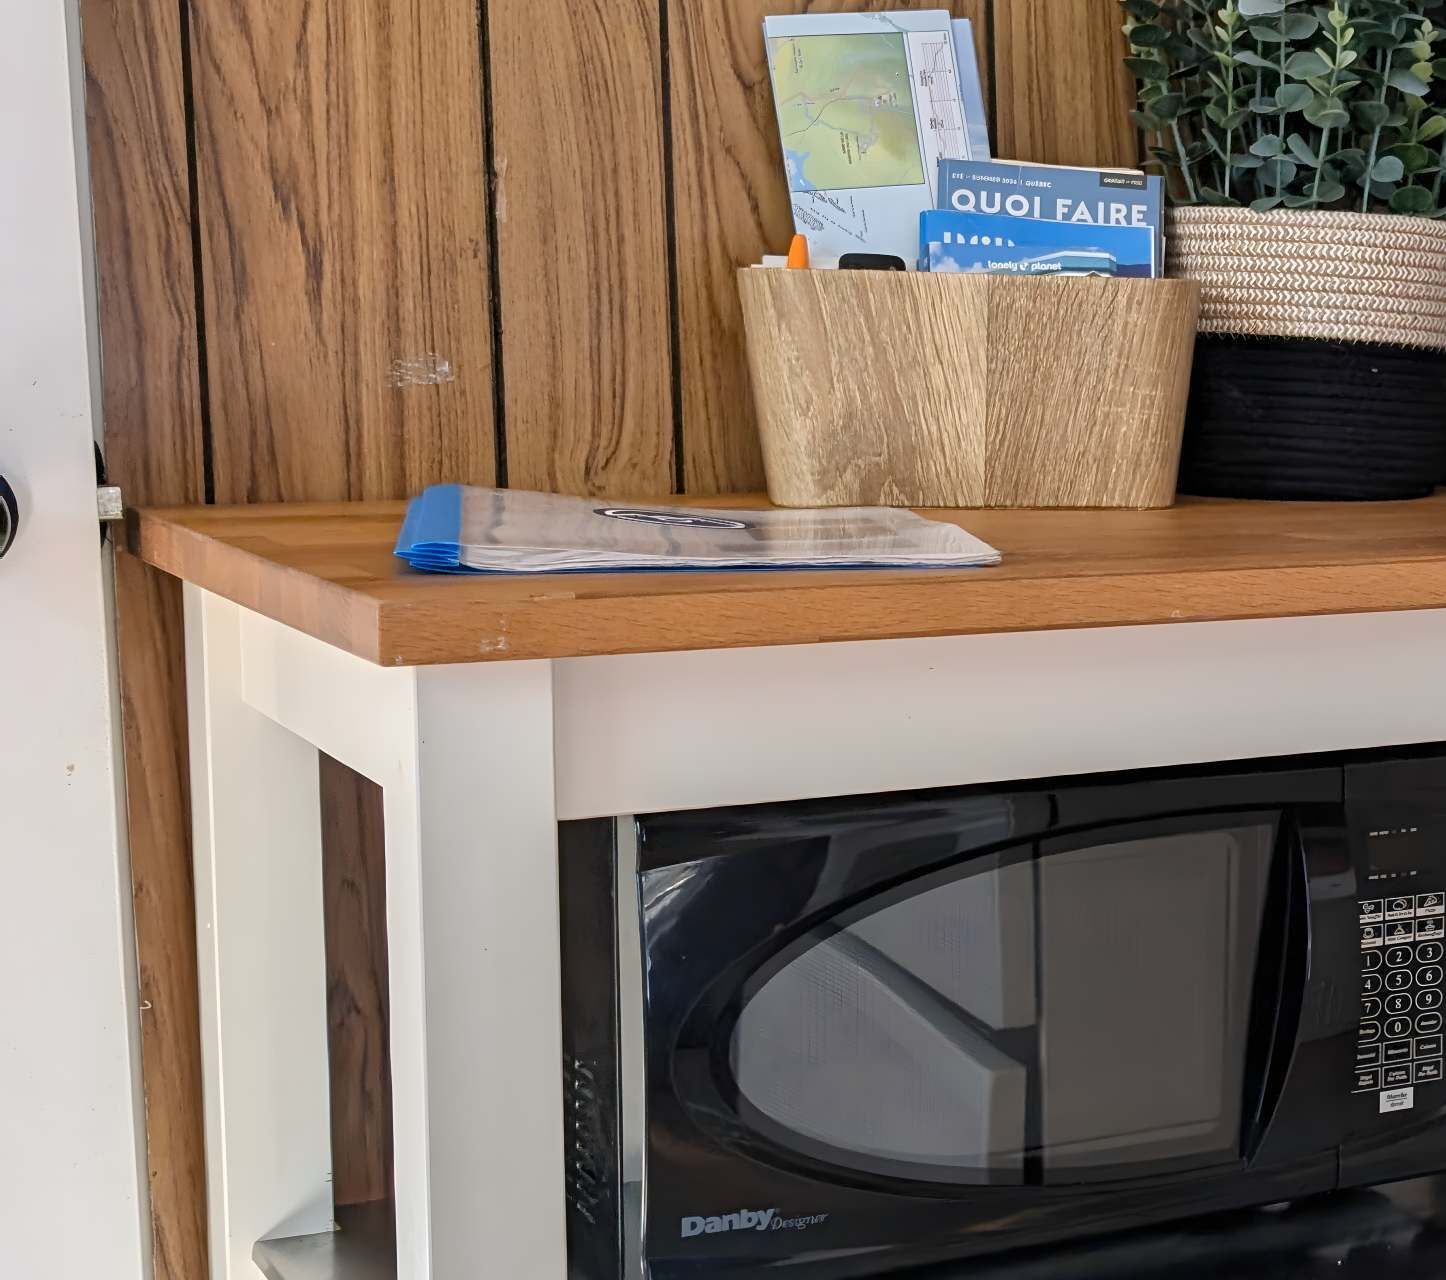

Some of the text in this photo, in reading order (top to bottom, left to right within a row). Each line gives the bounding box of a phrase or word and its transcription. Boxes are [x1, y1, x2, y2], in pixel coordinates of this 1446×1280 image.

[951, 188, 1148, 226] QUOI FAIRE
[987, 260, 1063, 272] lonely planet
[1366, 947, 1433, 966] 1 2 3
[1364, 970, 1433, 990] 4 5 6
[1365, 994, 1433, 1014] 7 8 9
[1394, 1021, 1401, 1033] 0
[681, 1209, 775, 1238] Danby
